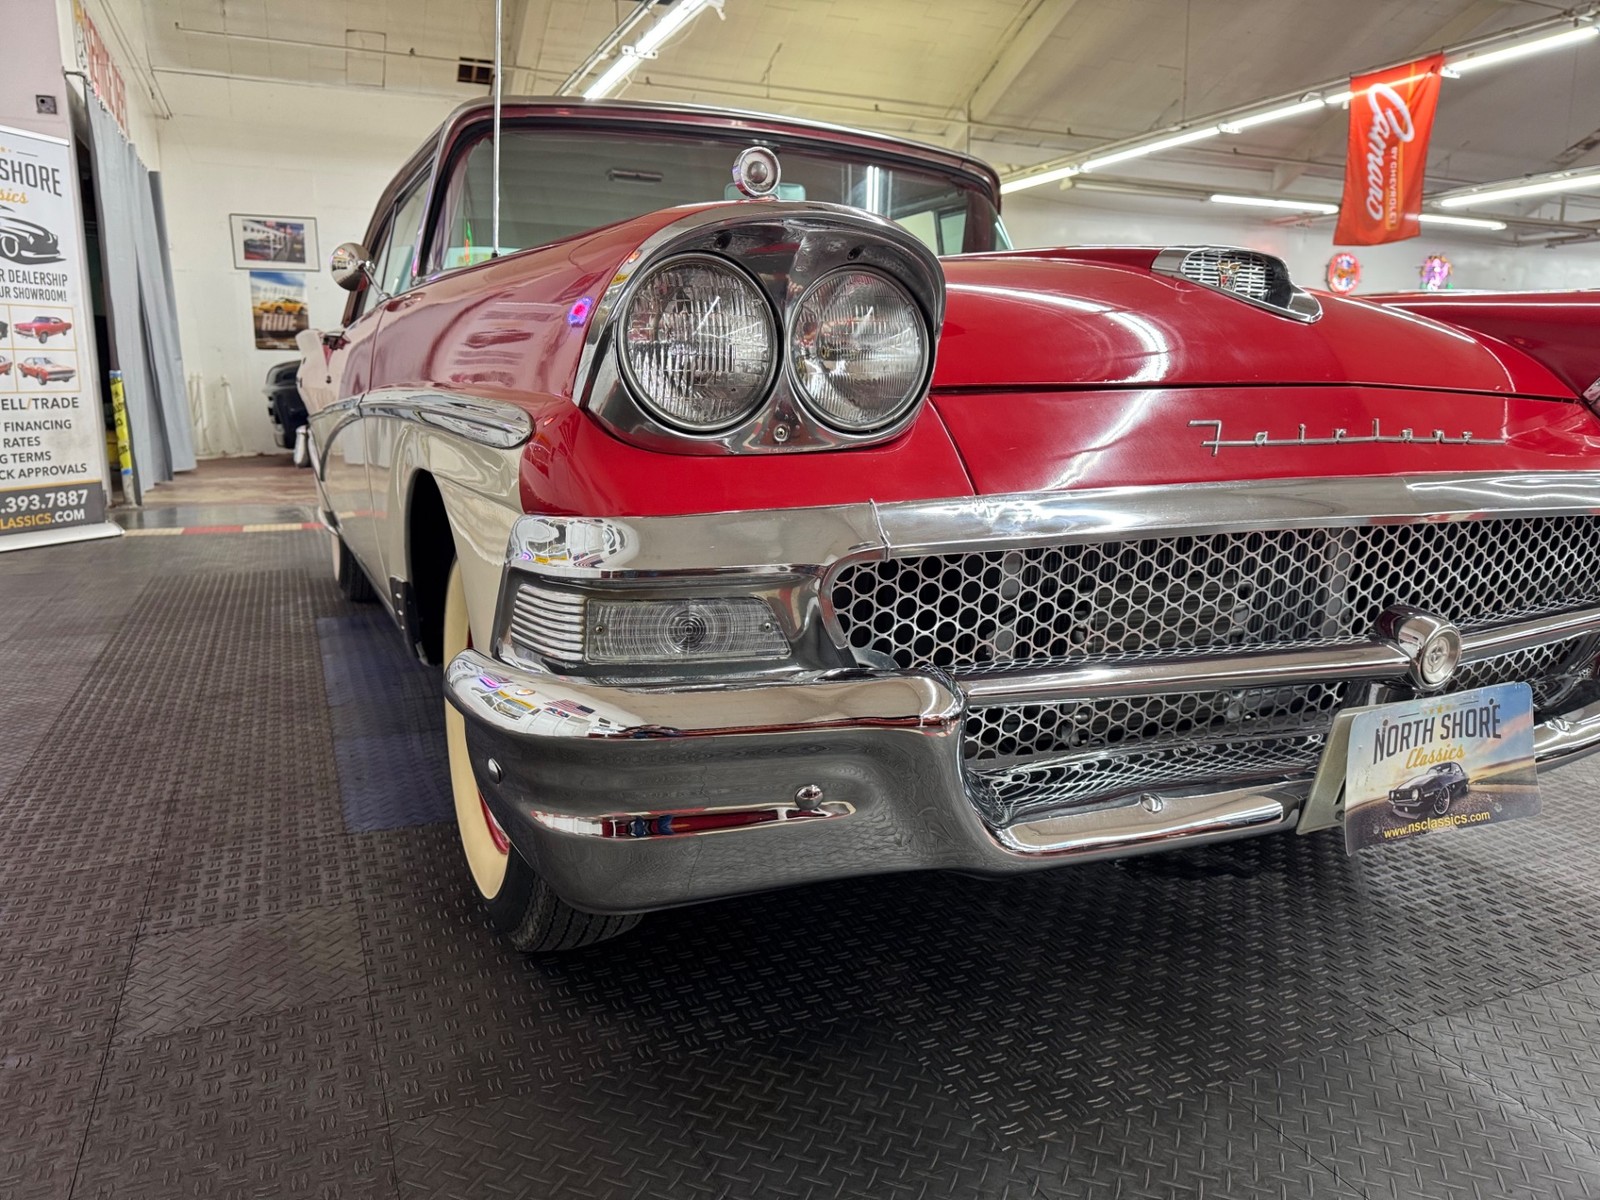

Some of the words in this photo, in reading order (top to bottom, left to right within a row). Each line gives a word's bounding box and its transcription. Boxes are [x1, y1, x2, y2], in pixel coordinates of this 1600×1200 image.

[1366, 83, 1415, 220] Camaro
[1391, 146, 1398, 160] BY
[1389, 161, 1397, 224] CHEVROLET
[8, 269, 68, 287] DEALERSHIP
[13, 287, 67, 302] SHOWROOM!
[261, 313, 297, 331] RIDE
[4, 419, 72, 432] FINANCING
[3, 436, 41, 448] RATES
[10, 451, 52, 463] TERMS
[18, 463, 87, 479] APPROVALS
[1373, 716, 1436, 765] NORTH
[1440, 704, 1502, 739] SHORE
[1405, 744, 1466, 769] Classics
[1384, 811, 1491, 838] www.nsclassics.com
